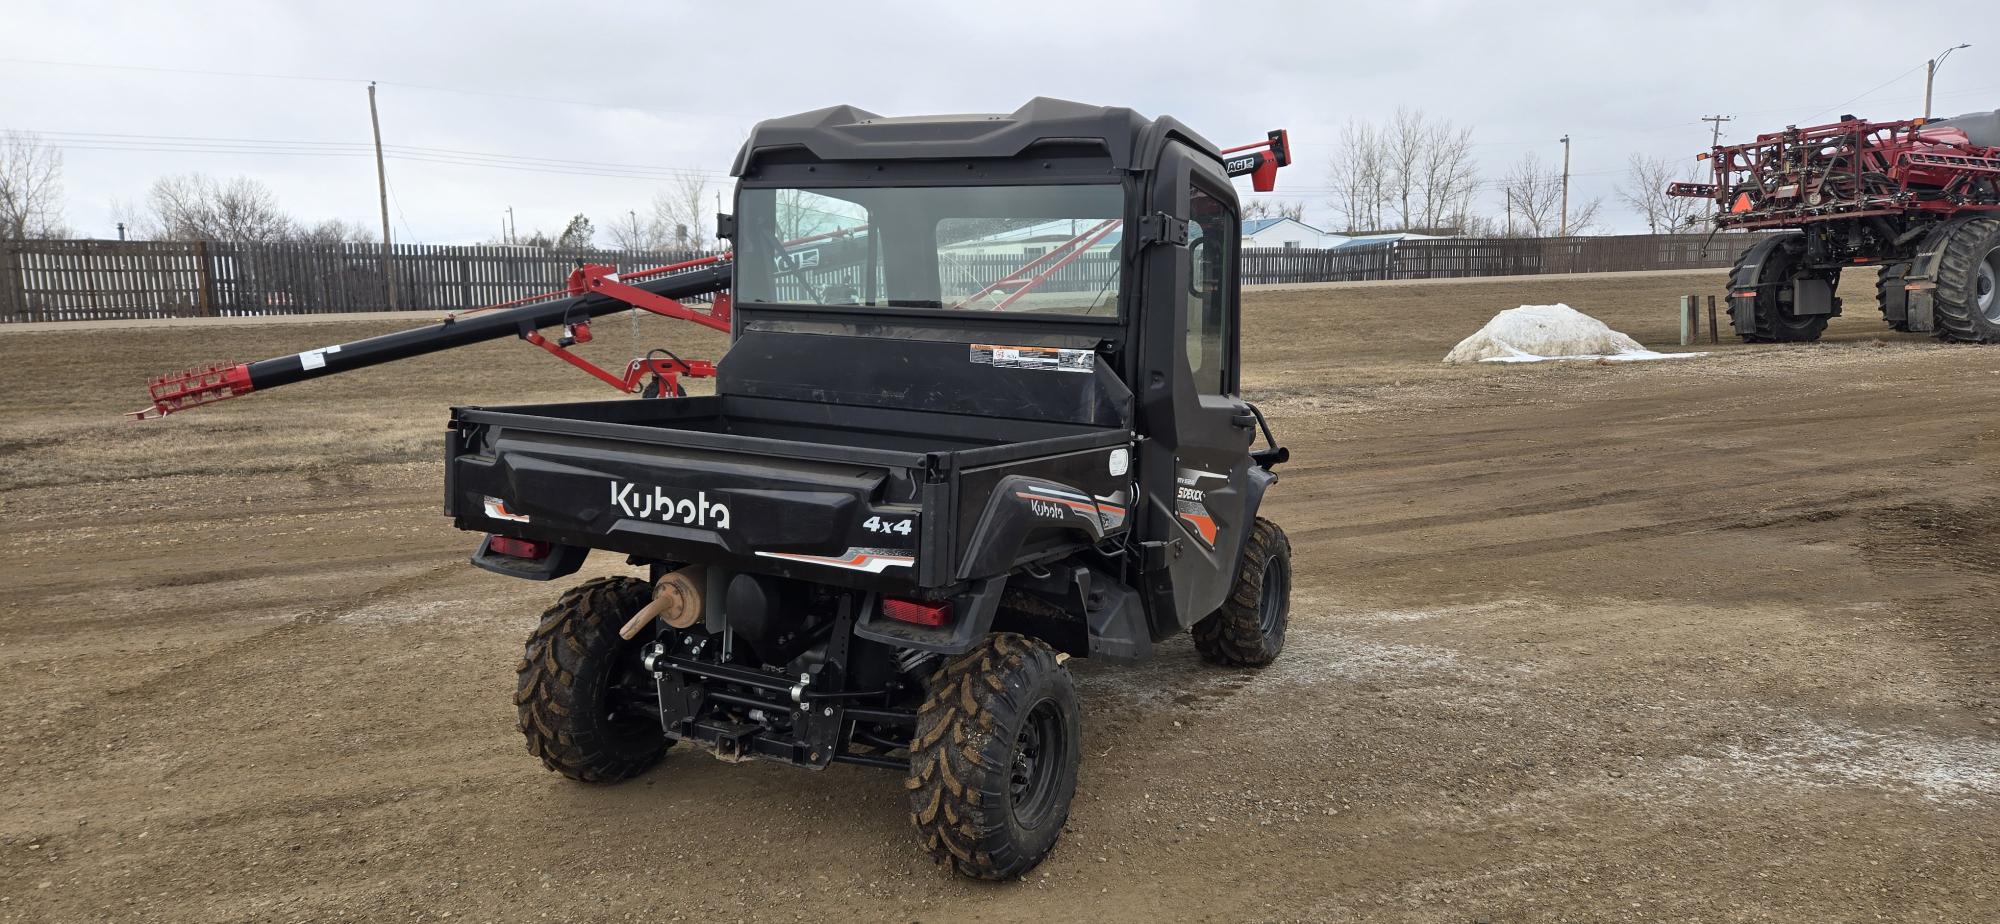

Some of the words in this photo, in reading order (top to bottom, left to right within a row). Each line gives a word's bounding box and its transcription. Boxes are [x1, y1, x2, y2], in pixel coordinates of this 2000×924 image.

[1227, 160, 1246, 173] AGI
[610, 480, 730, 529] Kubota
[1031, 499, 1064, 520] Kubota
[863, 515, 913, 535] 4x4
